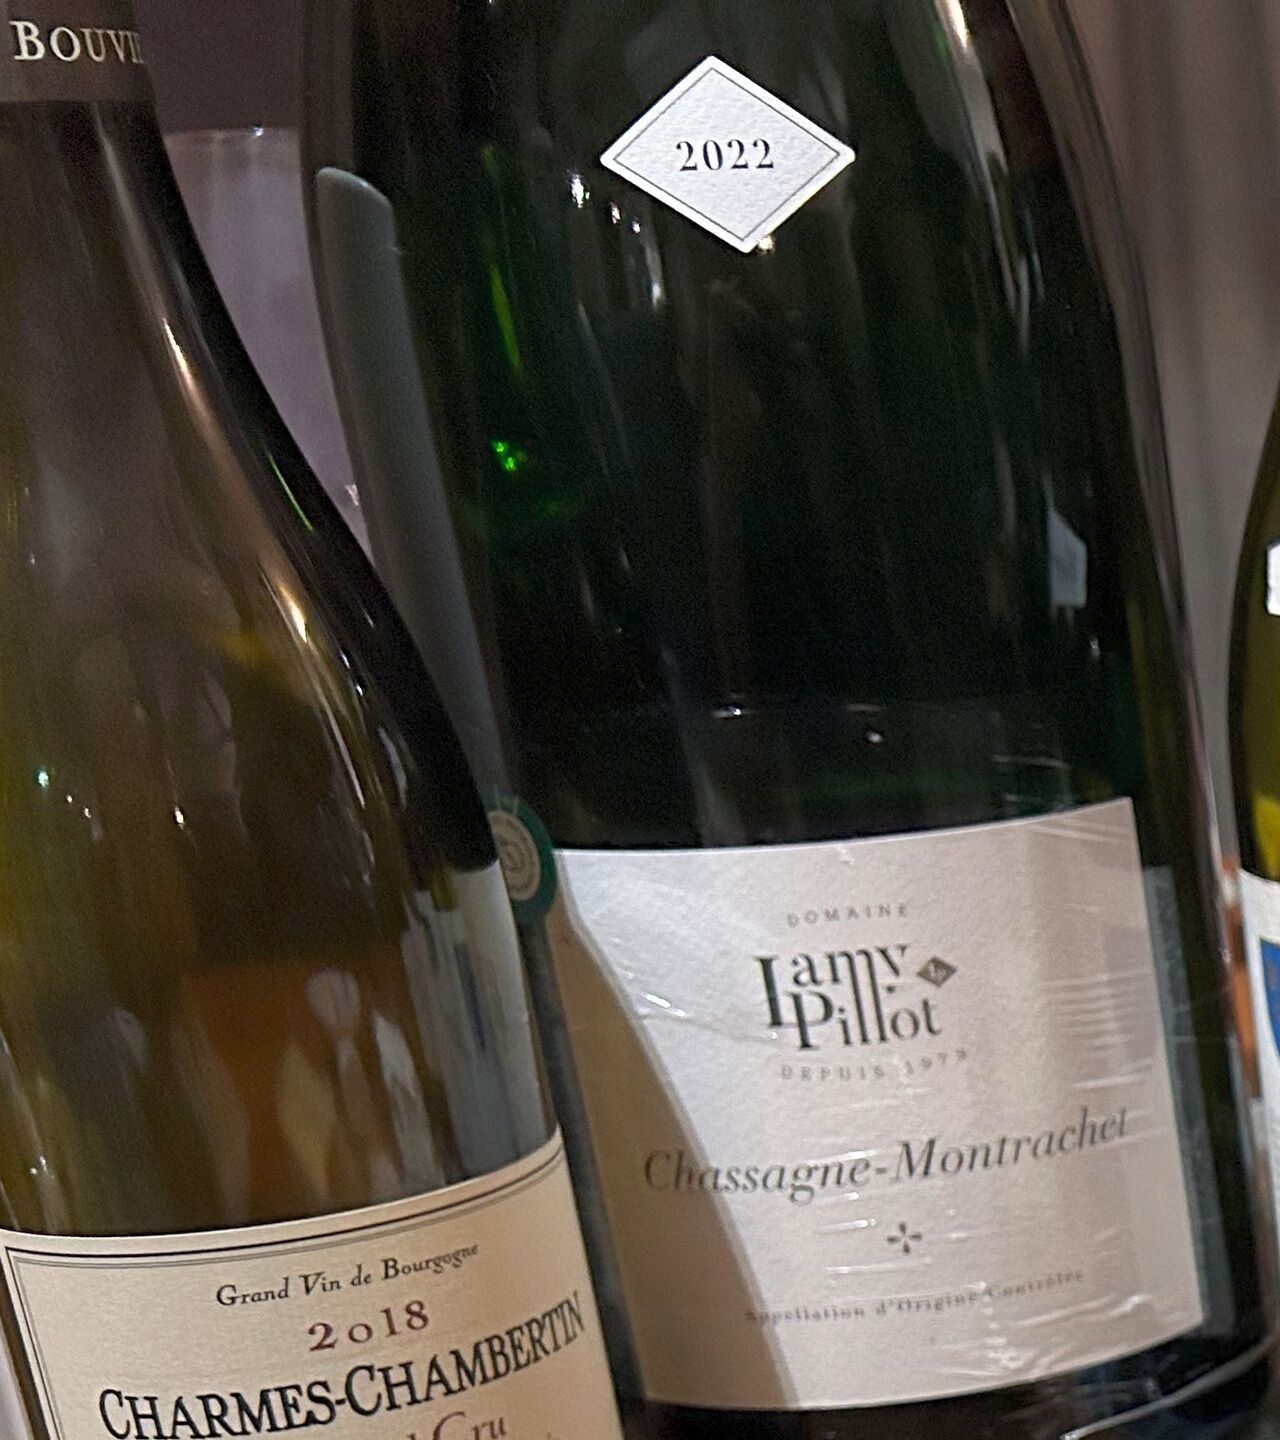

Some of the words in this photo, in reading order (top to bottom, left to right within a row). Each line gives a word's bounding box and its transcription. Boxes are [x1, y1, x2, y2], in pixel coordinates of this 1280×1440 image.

[676, 138, 774, 172] 2022
[786, 902, 908, 928] DOMAINE
[754, 942, 912, 1030] Lamy
[784, 984, 945, 1051] Pillot
[781, 1063, 886, 1081] DEPUIS
[644, 1103, 1128, 1205] Chassagne-Montrachet
[215, 1276, 290, 1308] Grand
[299, 1271, 342, 1297] Vin
[350, 1264, 373, 1287] de
[383, 1243, 480, 1281] Bourgogne
[307, 1299, 431, 1352] 2018
[99, 1290, 586, 1440] CHARMES-CHAMBERTIN
